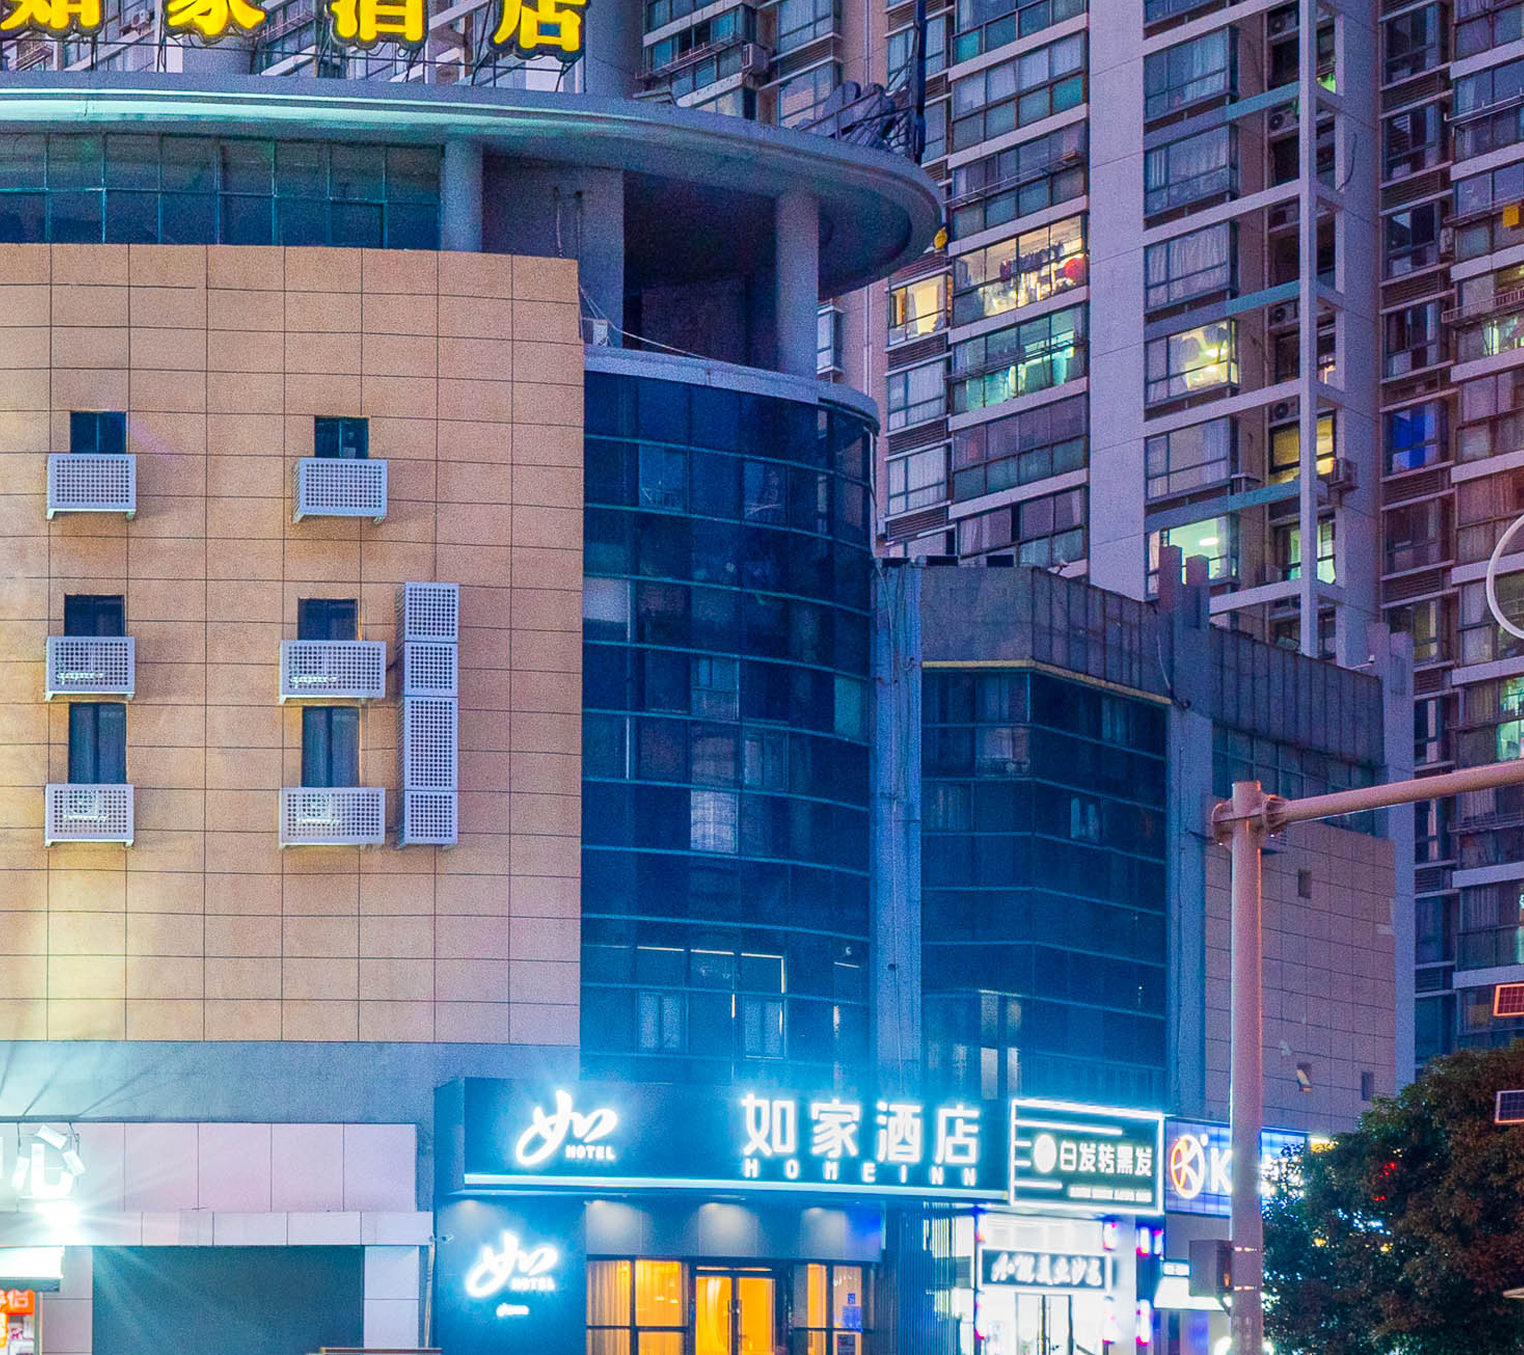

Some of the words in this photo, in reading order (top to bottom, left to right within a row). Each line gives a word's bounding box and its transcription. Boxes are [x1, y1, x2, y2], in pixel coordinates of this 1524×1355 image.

[741, 1094, 979, 1164] 如家酒店
[565, 1144, 615, 1160] HOTEL
